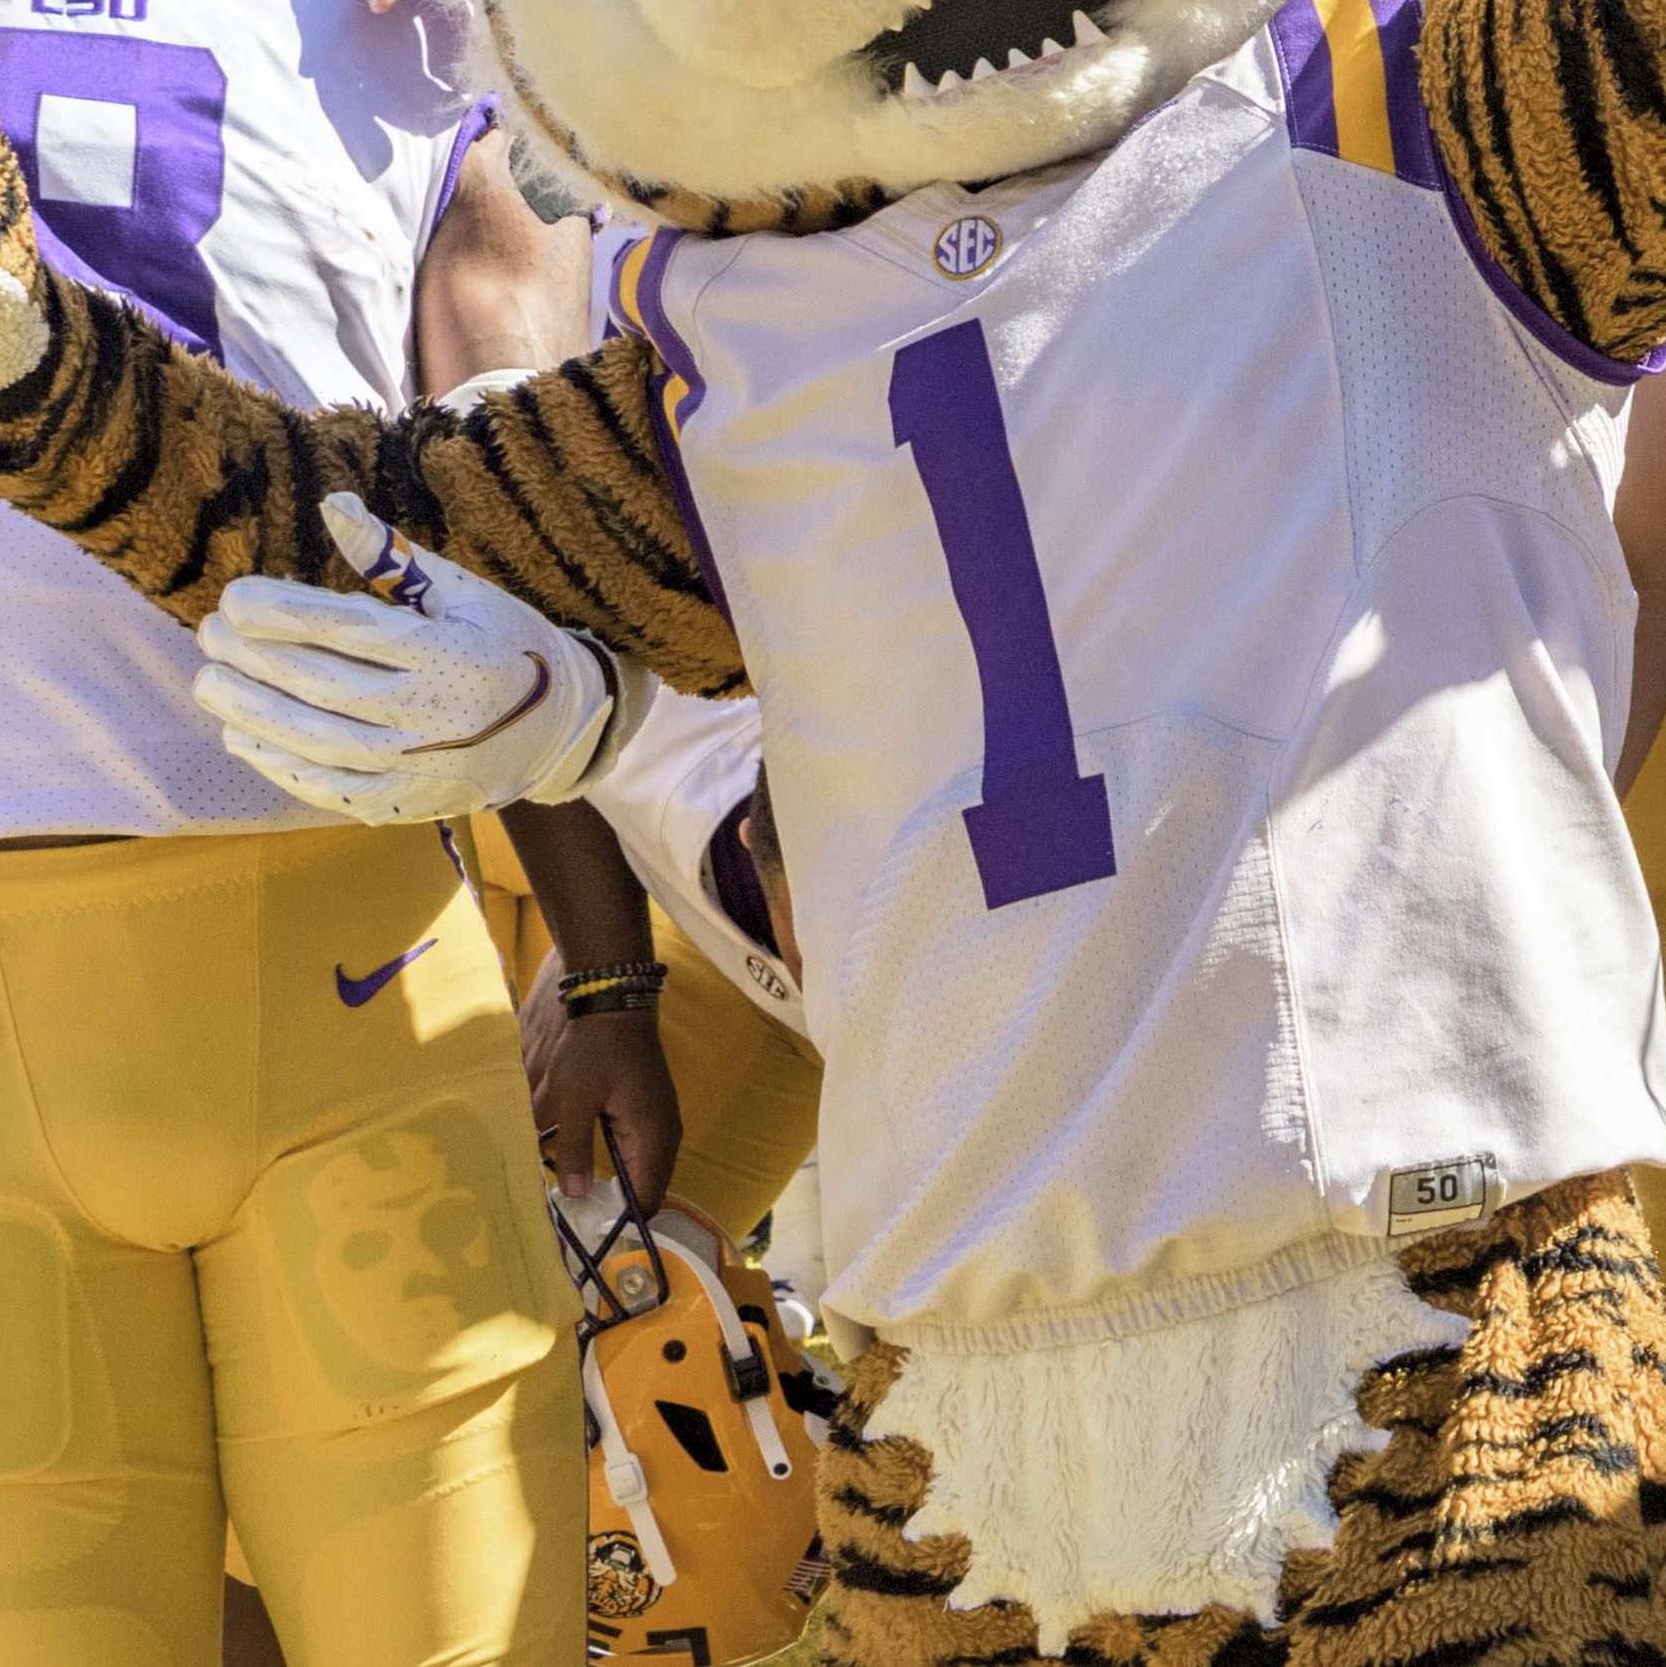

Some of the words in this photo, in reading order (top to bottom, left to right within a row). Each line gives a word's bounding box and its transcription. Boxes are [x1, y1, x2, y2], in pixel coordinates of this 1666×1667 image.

[937, 218, 1000, 279] SEC
[887, 317, 1117, 911] 1
[746, 956, 787, 1001] SEC
[1417, 1174, 1458, 1205] 50
